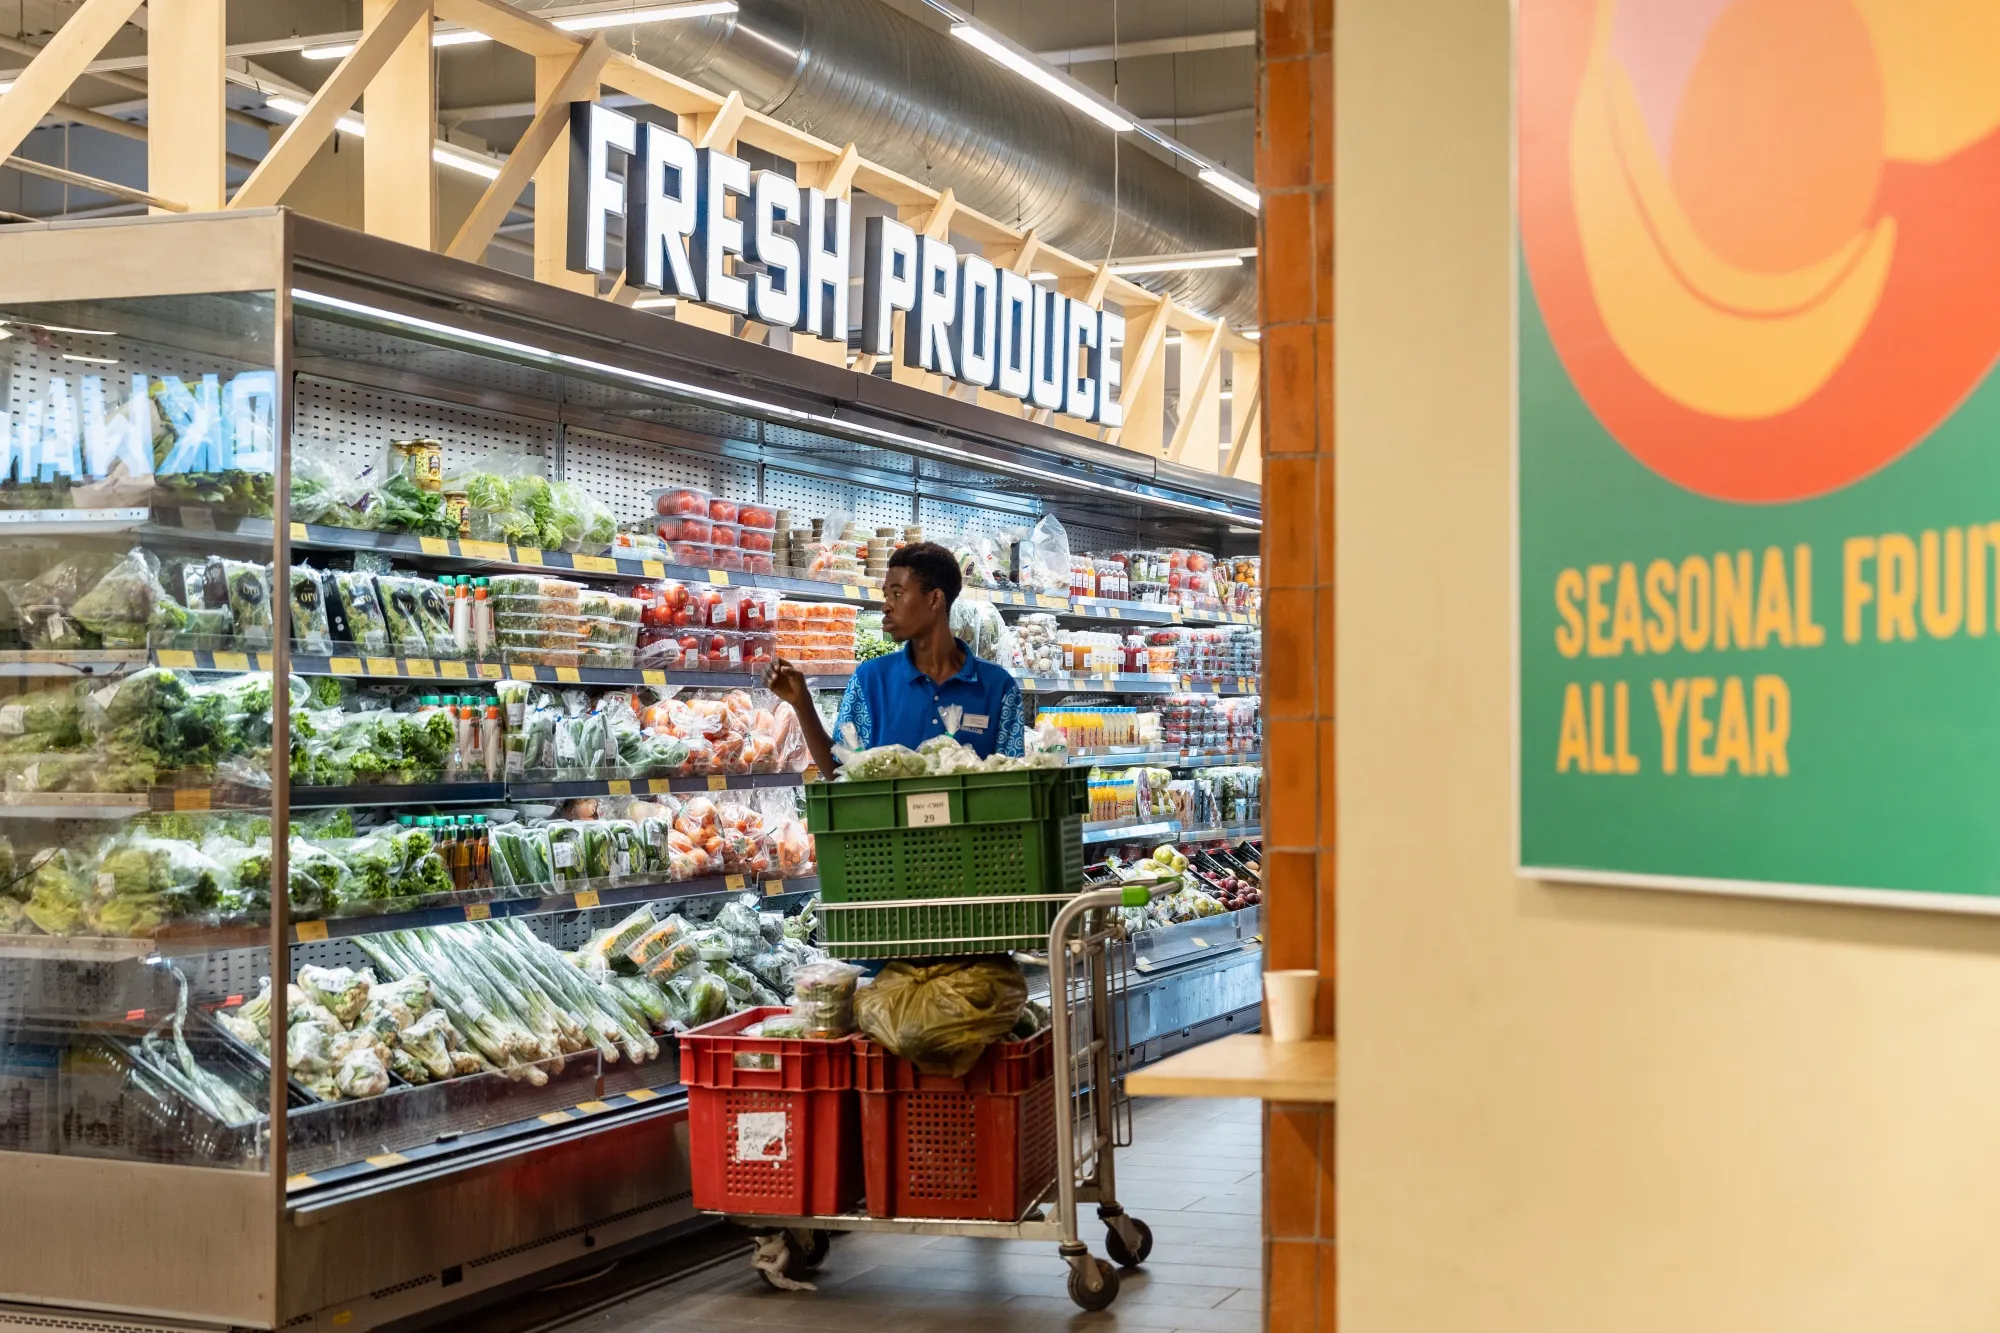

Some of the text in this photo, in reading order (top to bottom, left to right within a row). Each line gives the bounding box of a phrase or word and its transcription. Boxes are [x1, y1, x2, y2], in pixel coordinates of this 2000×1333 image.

[576, 101, 1126, 428] FRESH PRODUCE
[1554, 543, 1825, 659] SEASONAL
[1556, 673, 1791, 776] ALL YEAR
[923, 814, 935, 823] 29
